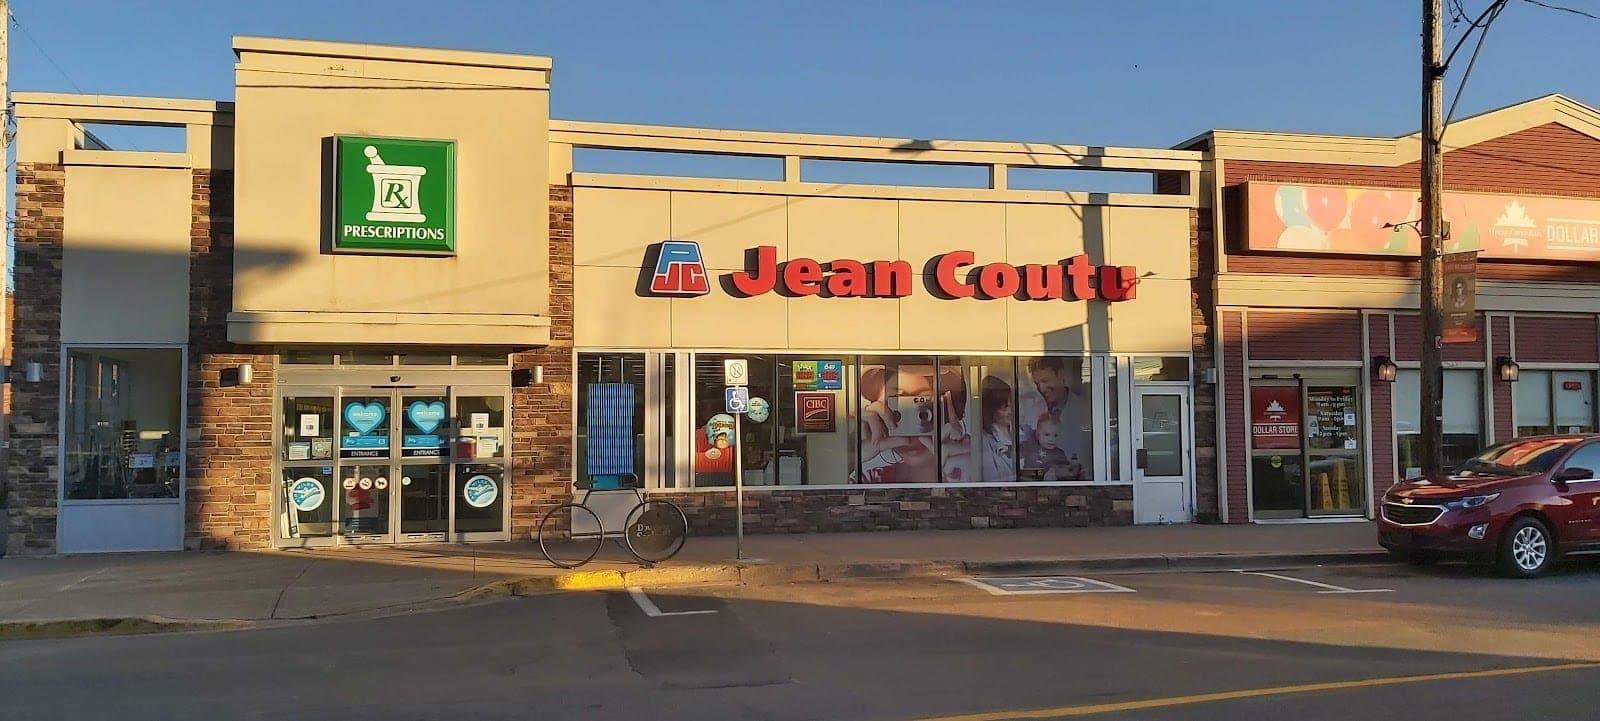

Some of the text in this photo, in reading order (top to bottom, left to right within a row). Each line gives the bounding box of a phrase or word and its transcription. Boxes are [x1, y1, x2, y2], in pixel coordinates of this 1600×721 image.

[343, 224, 445, 241] PRESCRIPTIONS
[1547, 224, 1600, 244] DOLLAR
[653, 243, 708, 292] PJC
[732, 245, 1137, 302] Jean Coutu
[806, 399, 827, 409] CIBC
[1253, 425, 1299, 434] DOLLAR STORE
